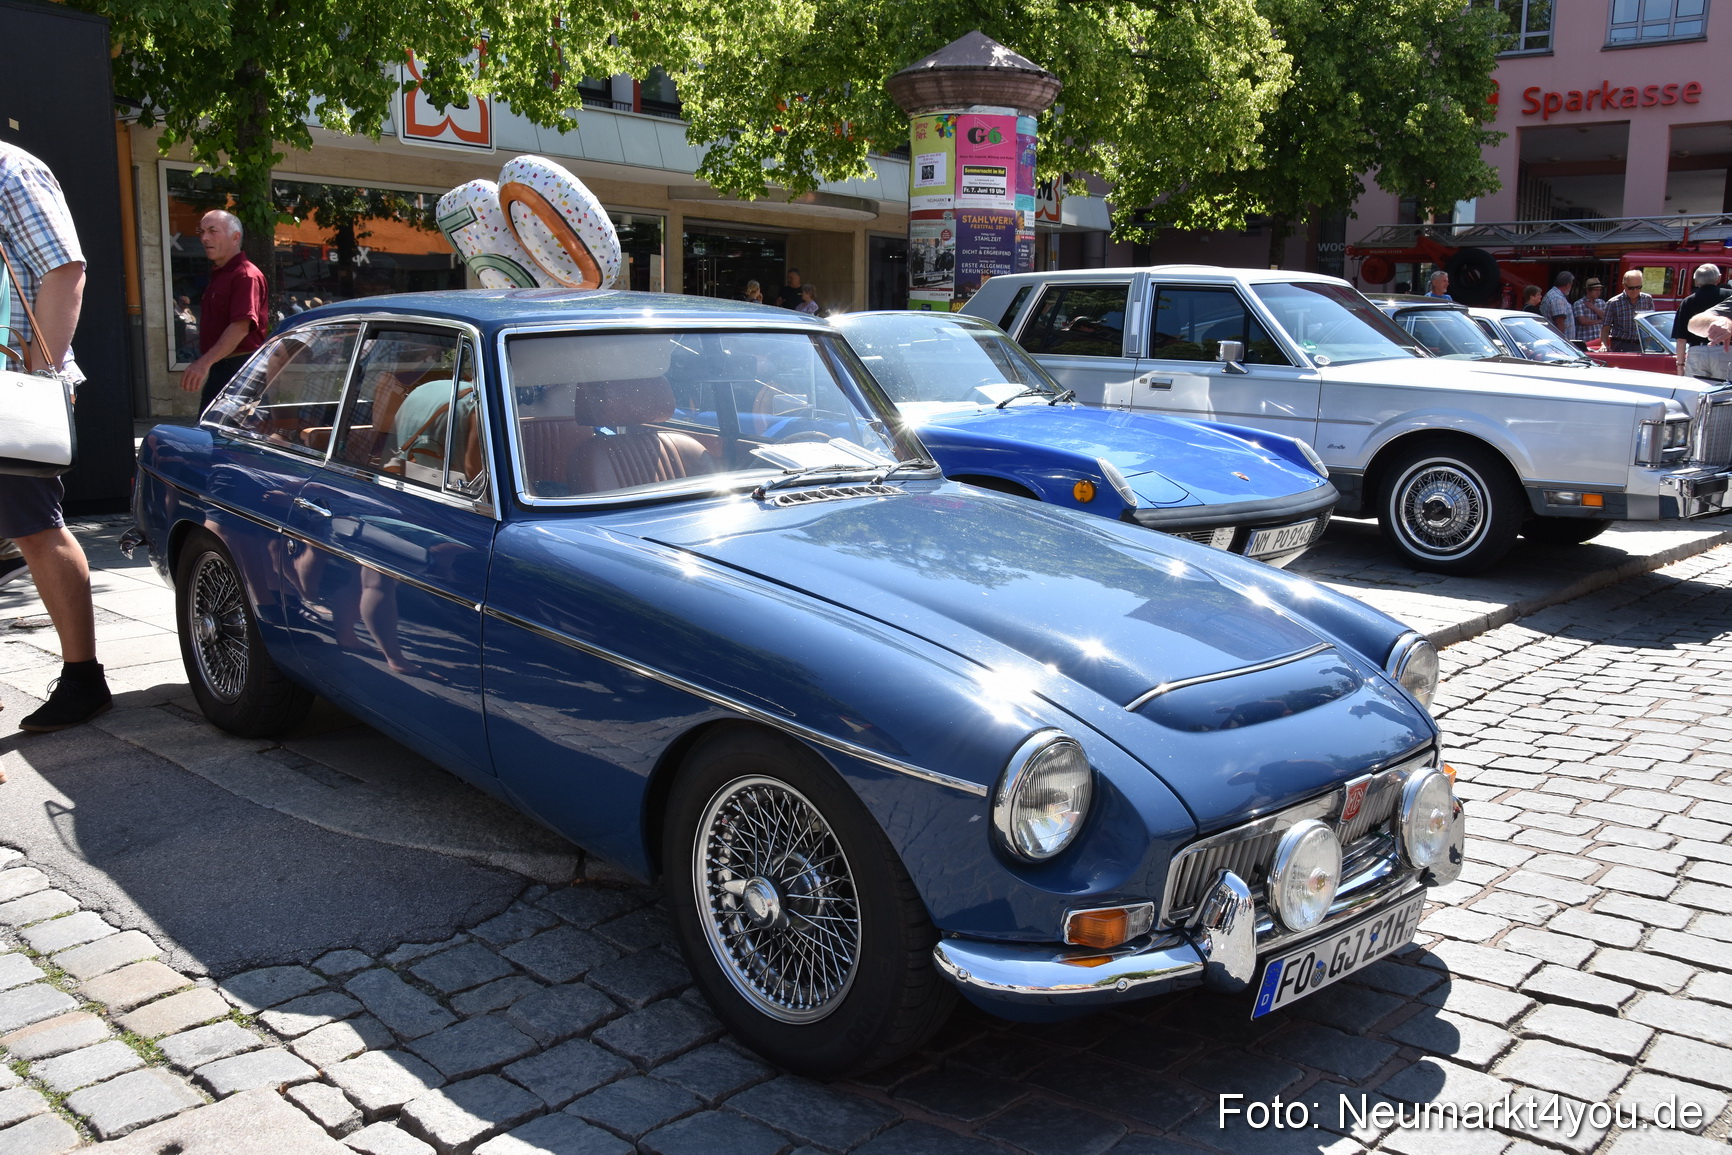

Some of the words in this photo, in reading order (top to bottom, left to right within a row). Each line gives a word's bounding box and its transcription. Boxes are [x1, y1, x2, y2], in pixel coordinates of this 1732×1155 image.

[1521, 80, 1702, 120] Sparkasse
[967, 126, 1002, 144] G6
[962, 215, 1014, 225] STAHLWERK
[1251, 532, 1271, 553] NM
[1411, 900, 1422, 912] 03
[1404, 926, 1413, 940] 10
[1275, 951, 1315, 1004] FO
[1329, 929, 1365, 978] GJ
[1362, 905, 1411, 963] 21H
[1261, 994, 1269, 1006] D
